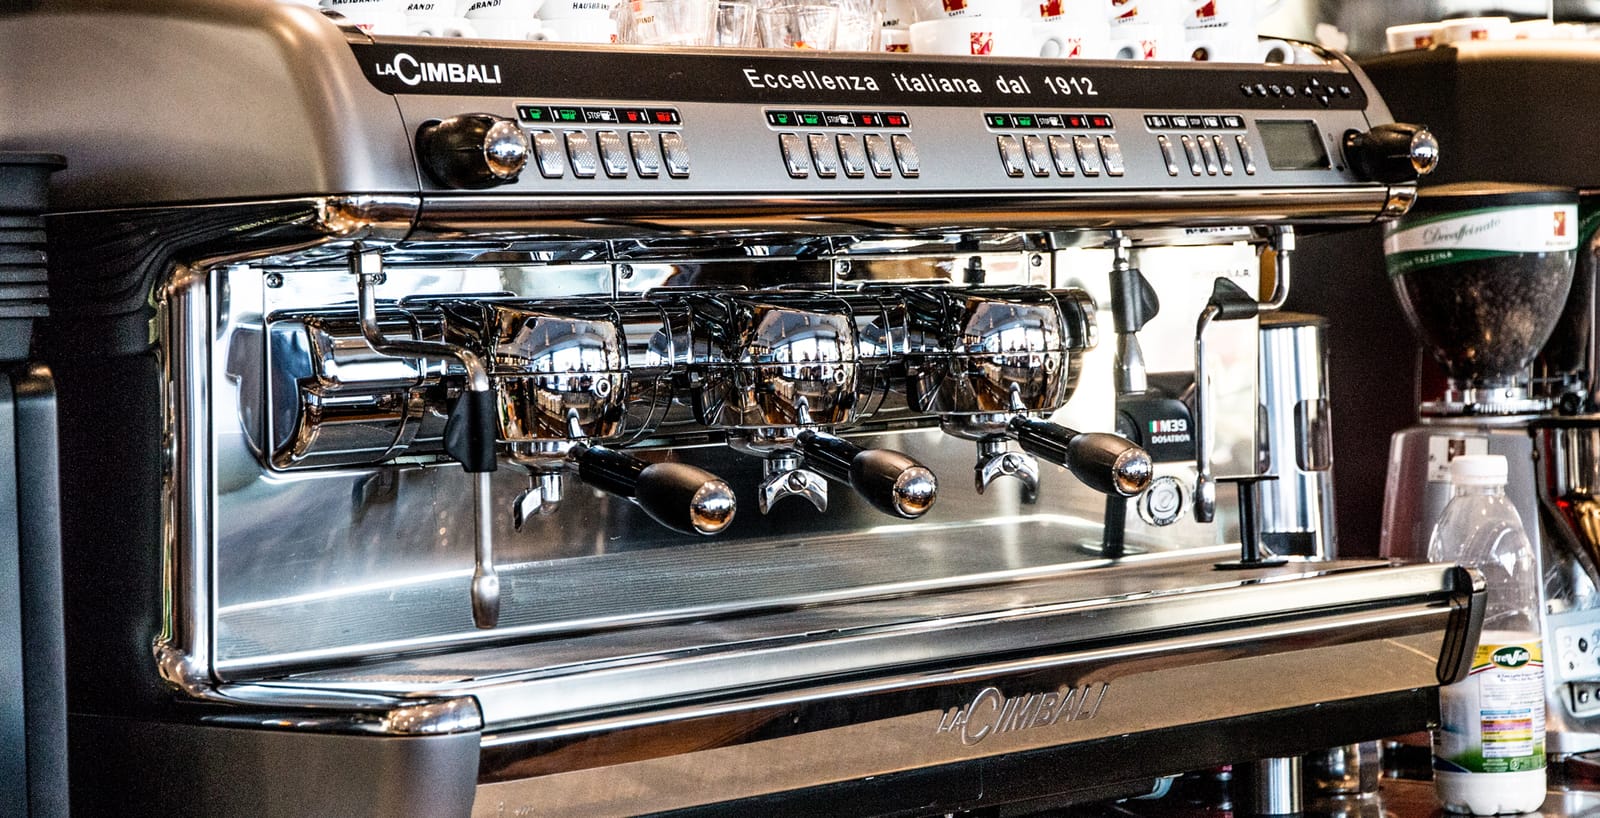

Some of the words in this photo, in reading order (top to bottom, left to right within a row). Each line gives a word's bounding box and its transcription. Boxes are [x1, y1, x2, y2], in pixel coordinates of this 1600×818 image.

[375, 63, 396, 76] LA
[393, 53, 502, 86] CIMBALI
[743, 68, 880, 92] Eccellenza
[891, 72, 982, 94] italiana
[995, 75, 1032, 95] dal
[1044, 75, 1099, 96] 1912
[587, 111, 600, 120] STOP
[1160, 419, 1188, 433] M39
[1151, 433, 1191, 445] DOSATRON
[935, 711, 967, 735] LA
[960, 686, 1111, 746] CIMBALI
